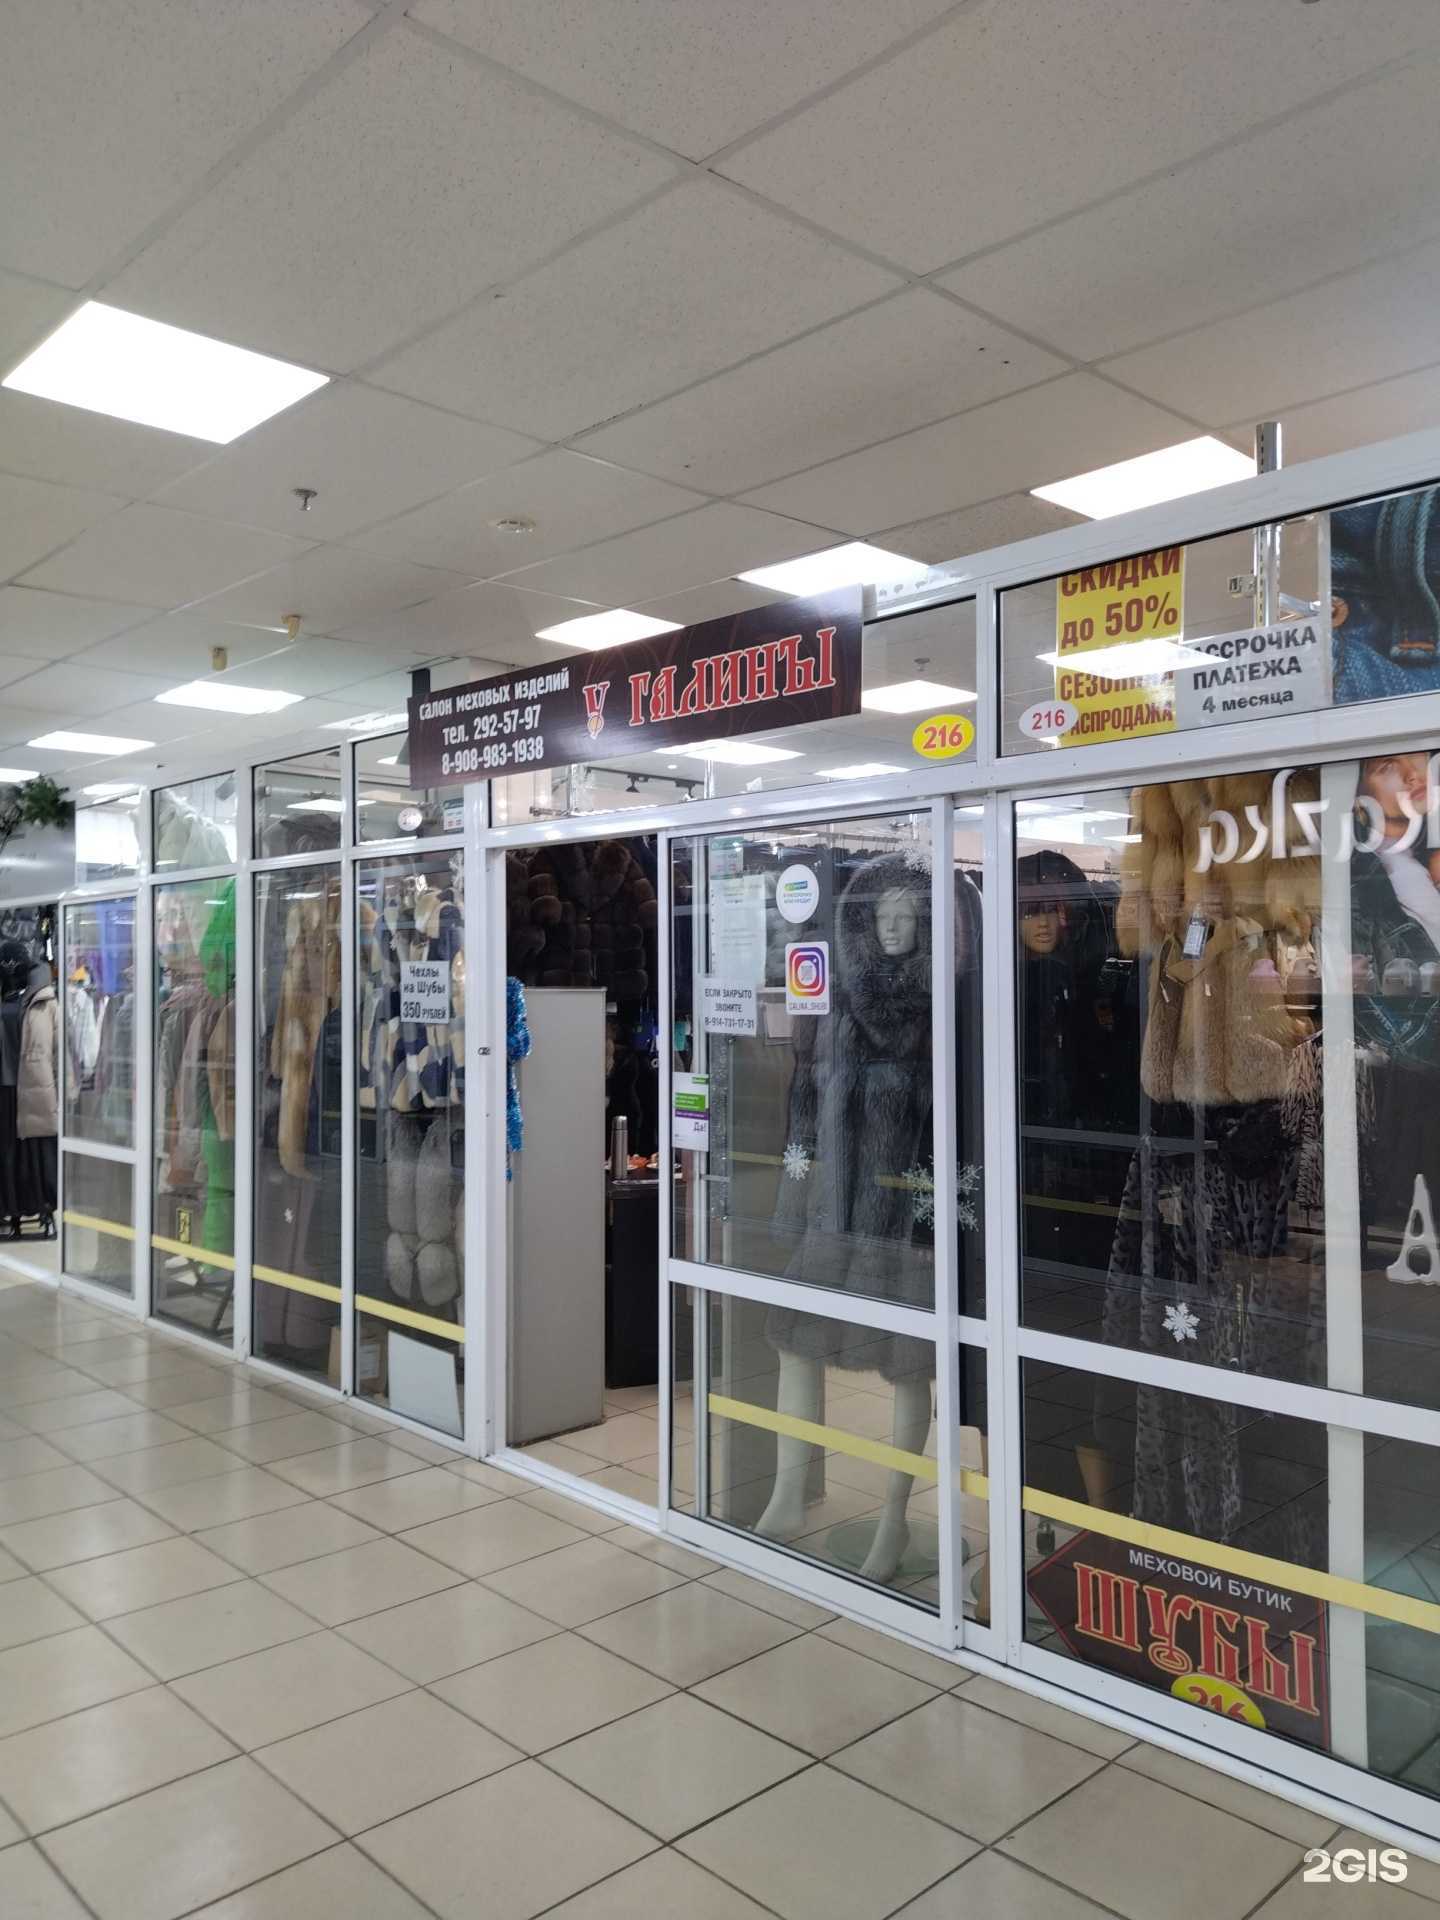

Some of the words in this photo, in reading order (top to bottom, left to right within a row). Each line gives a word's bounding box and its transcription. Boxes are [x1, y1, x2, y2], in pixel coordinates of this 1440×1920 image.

[1061, 546, 1181, 597] СКИДКИ
[1105, 592, 1178, 636] 50%
[1193, 626, 1317, 659] ССРОЧКА
[456, 684, 510, 713] меховых
[514, 667, 570, 701] изделий
[629, 627, 836, 726] ГАЛИНЫ
[1193, 656, 1302, 690] ПЛАТЕЖА
[1032, 708, 1065, 731] 216
[1069, 700, 1173, 736] АСПРОДАЖА
[1202, 696, 1216, 713] 4
[1222, 690, 1294, 712] месяца
[442, 724, 469, 746] тел.
[473, 704, 542, 741] 292-57-97
[923, 723, 963, 750] 216
[442, 736, 544, 776] 8-908-983-1938
[402, 1001, 421, 1018] 350
[1129, 1549, 1222, 1592] МЕХОВОЙ
[1228, 1579, 1293, 1614] БУТИК
[1073, 1562, 1320, 1717] ШУБЫ
